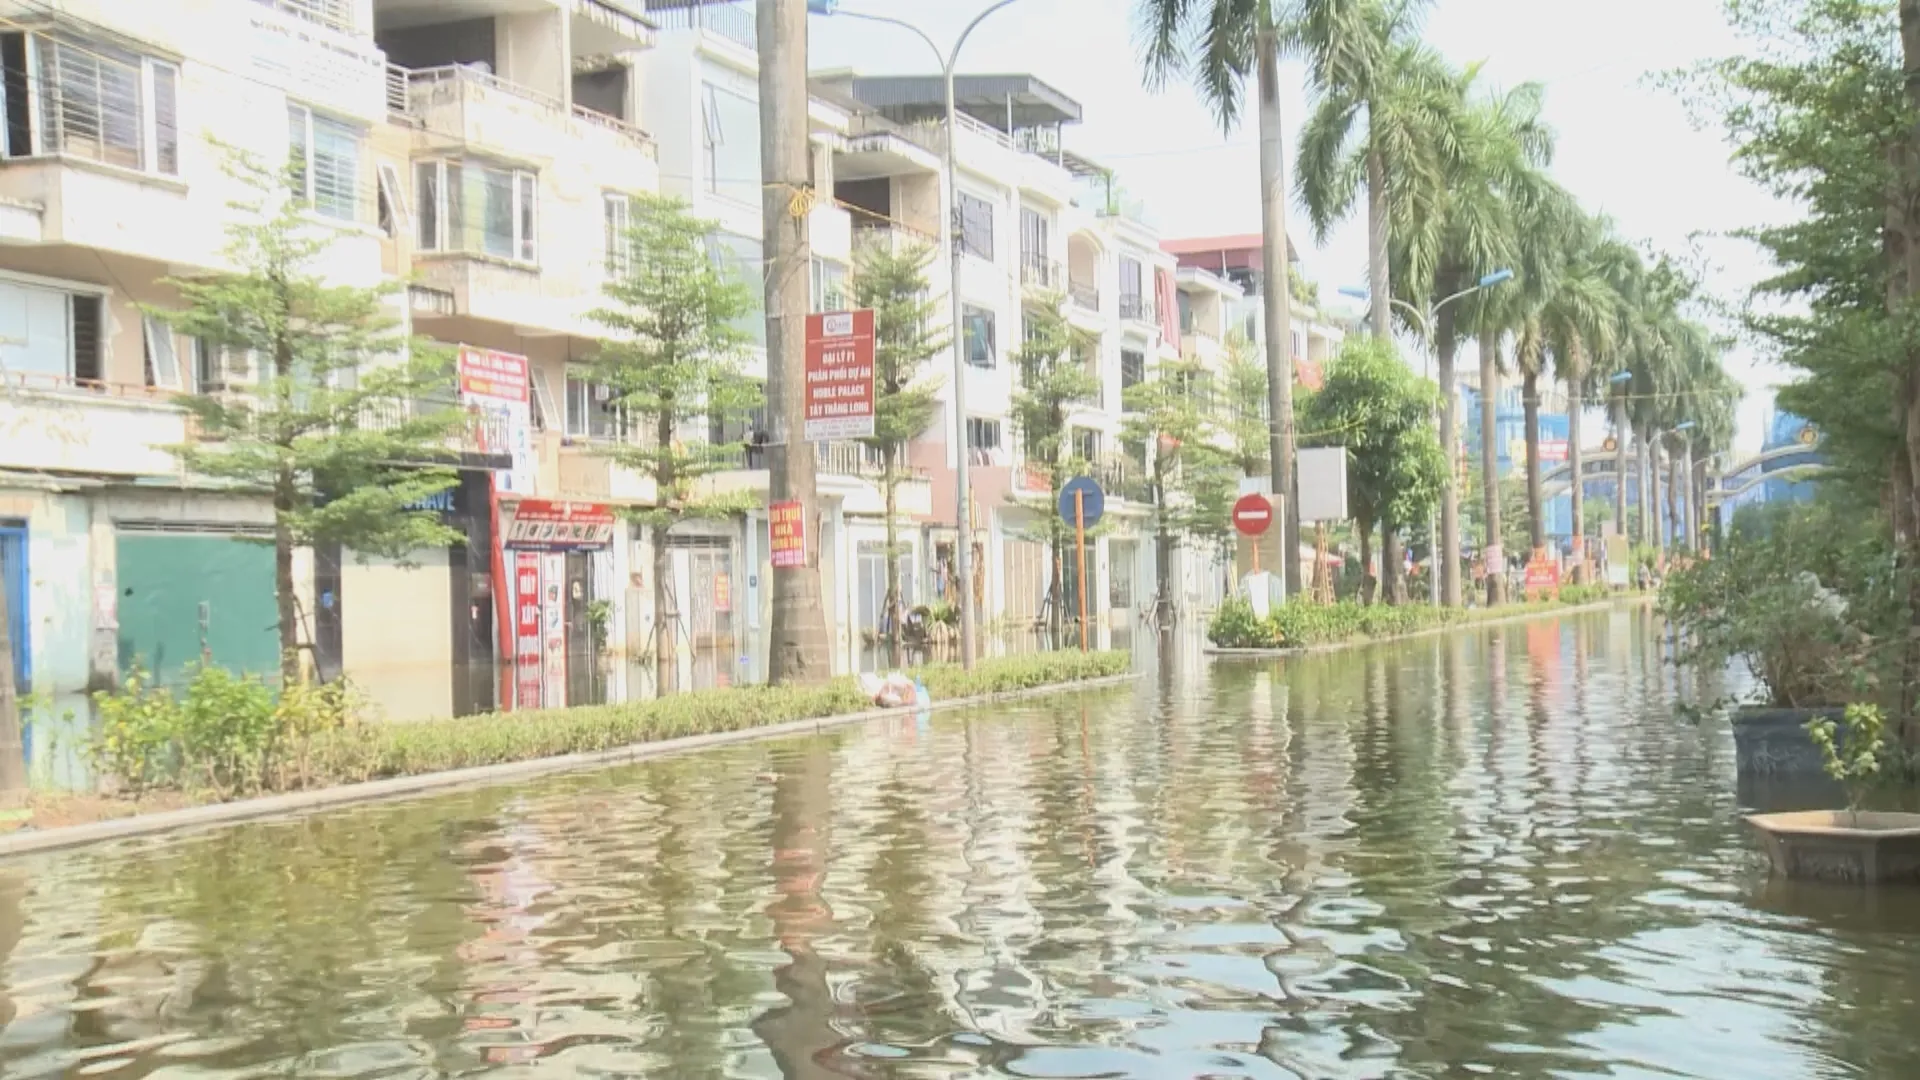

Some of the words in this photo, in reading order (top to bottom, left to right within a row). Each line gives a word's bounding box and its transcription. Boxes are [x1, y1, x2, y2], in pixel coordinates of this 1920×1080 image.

[838, 383, 865, 398] PALACE
[809, 401, 823, 417] TÂY
[849, 401, 870, 414] LONG
